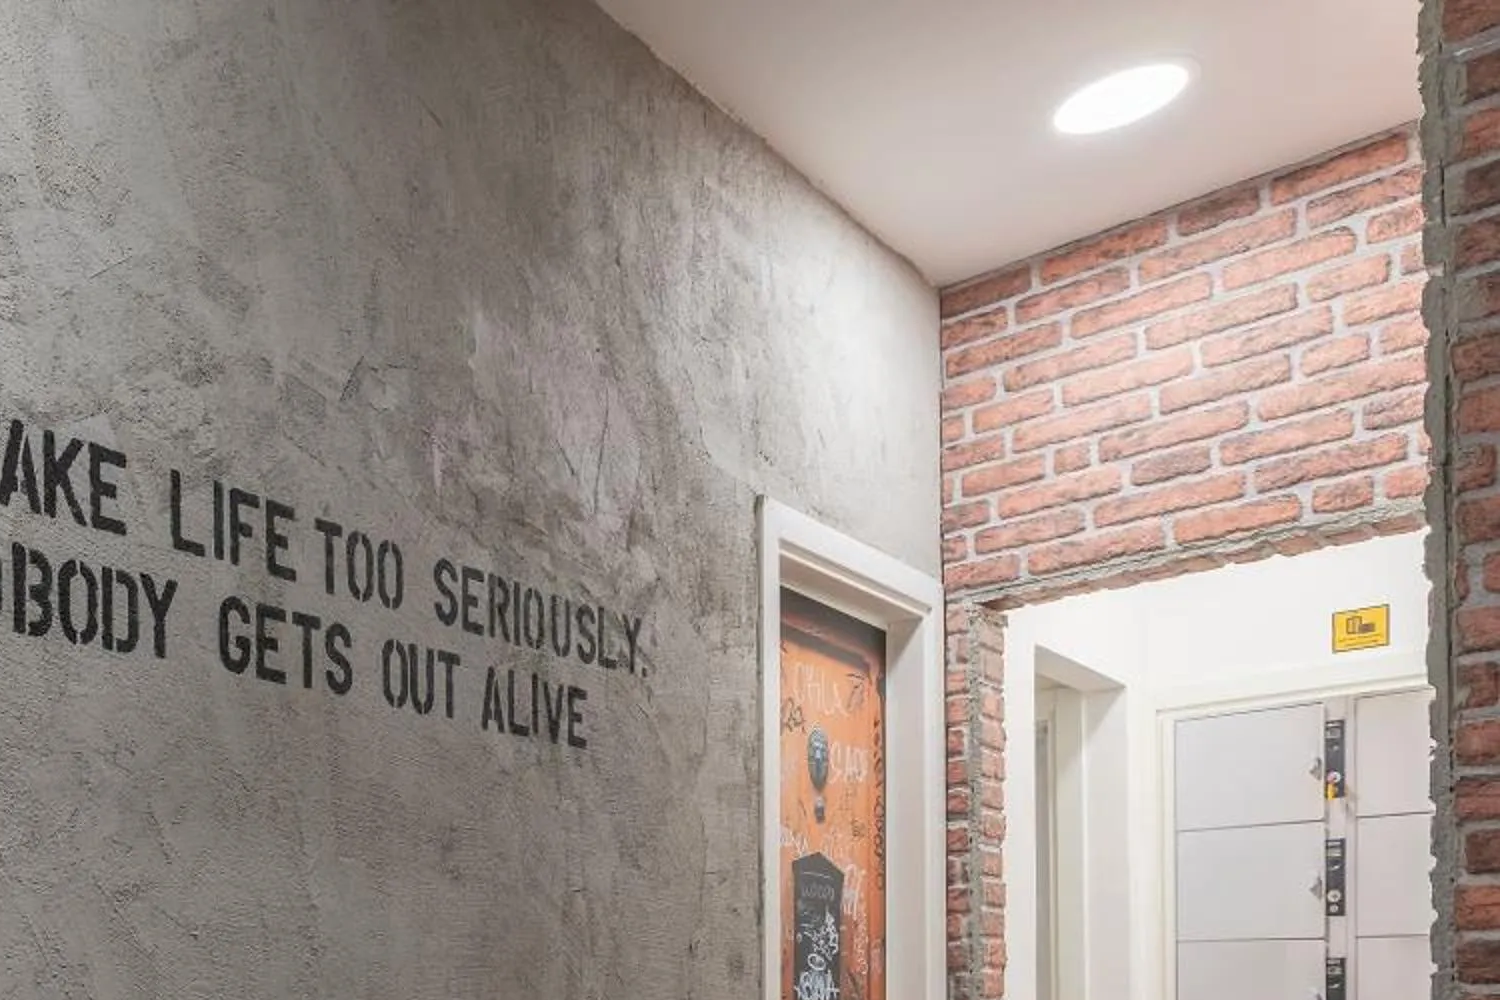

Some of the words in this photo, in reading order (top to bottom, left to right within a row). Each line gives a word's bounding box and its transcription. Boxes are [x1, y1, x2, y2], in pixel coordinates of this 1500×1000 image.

[170, 469, 296, 581] LIFE
[314, 518, 404, 609] TOO
[218, 597, 353, 695] GETS
[382, 638, 461, 718] OUT
[480, 666, 588, 748] ALIVE
